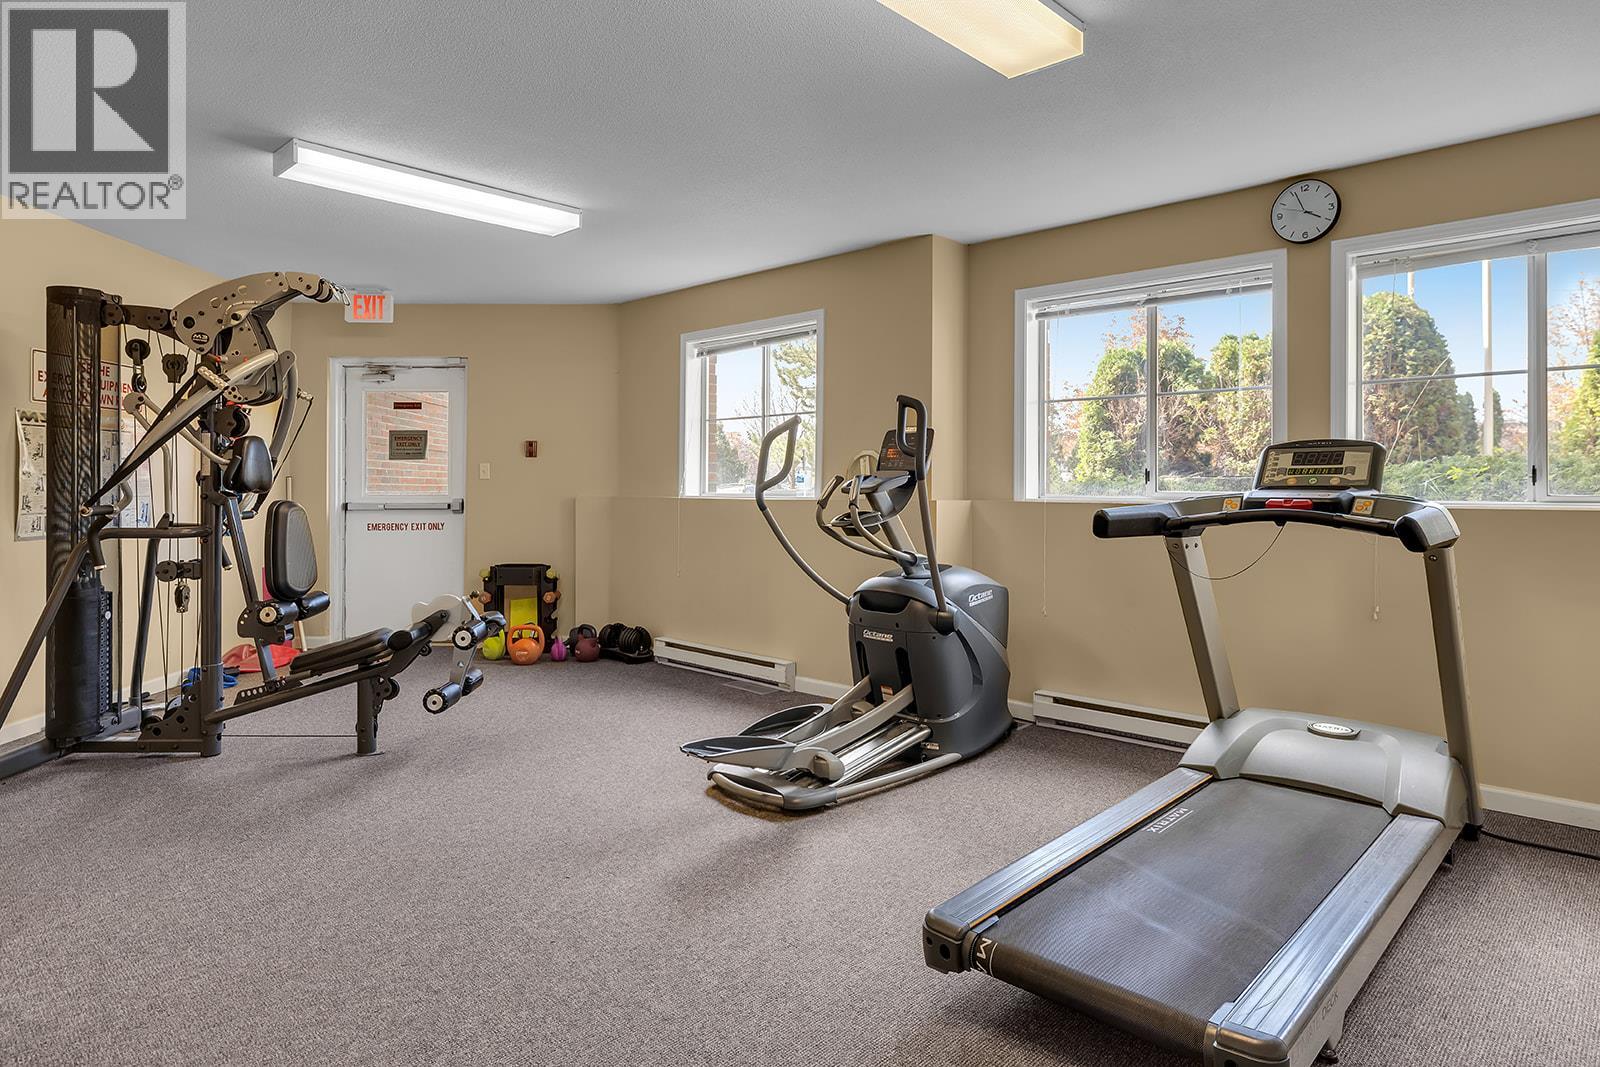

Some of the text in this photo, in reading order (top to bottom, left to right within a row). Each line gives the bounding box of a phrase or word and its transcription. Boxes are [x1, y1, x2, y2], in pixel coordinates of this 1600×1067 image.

[1300, 184, 1310, 192] 12
[1328, 203, 1335, 211] 3
[1276, 213, 1284, 221] 9
[1301, 231, 1309, 239] 6
[353, 294, 385, 320] EXIT
[367, 522, 445, 531] EMERGENCY EXIT ONLY
